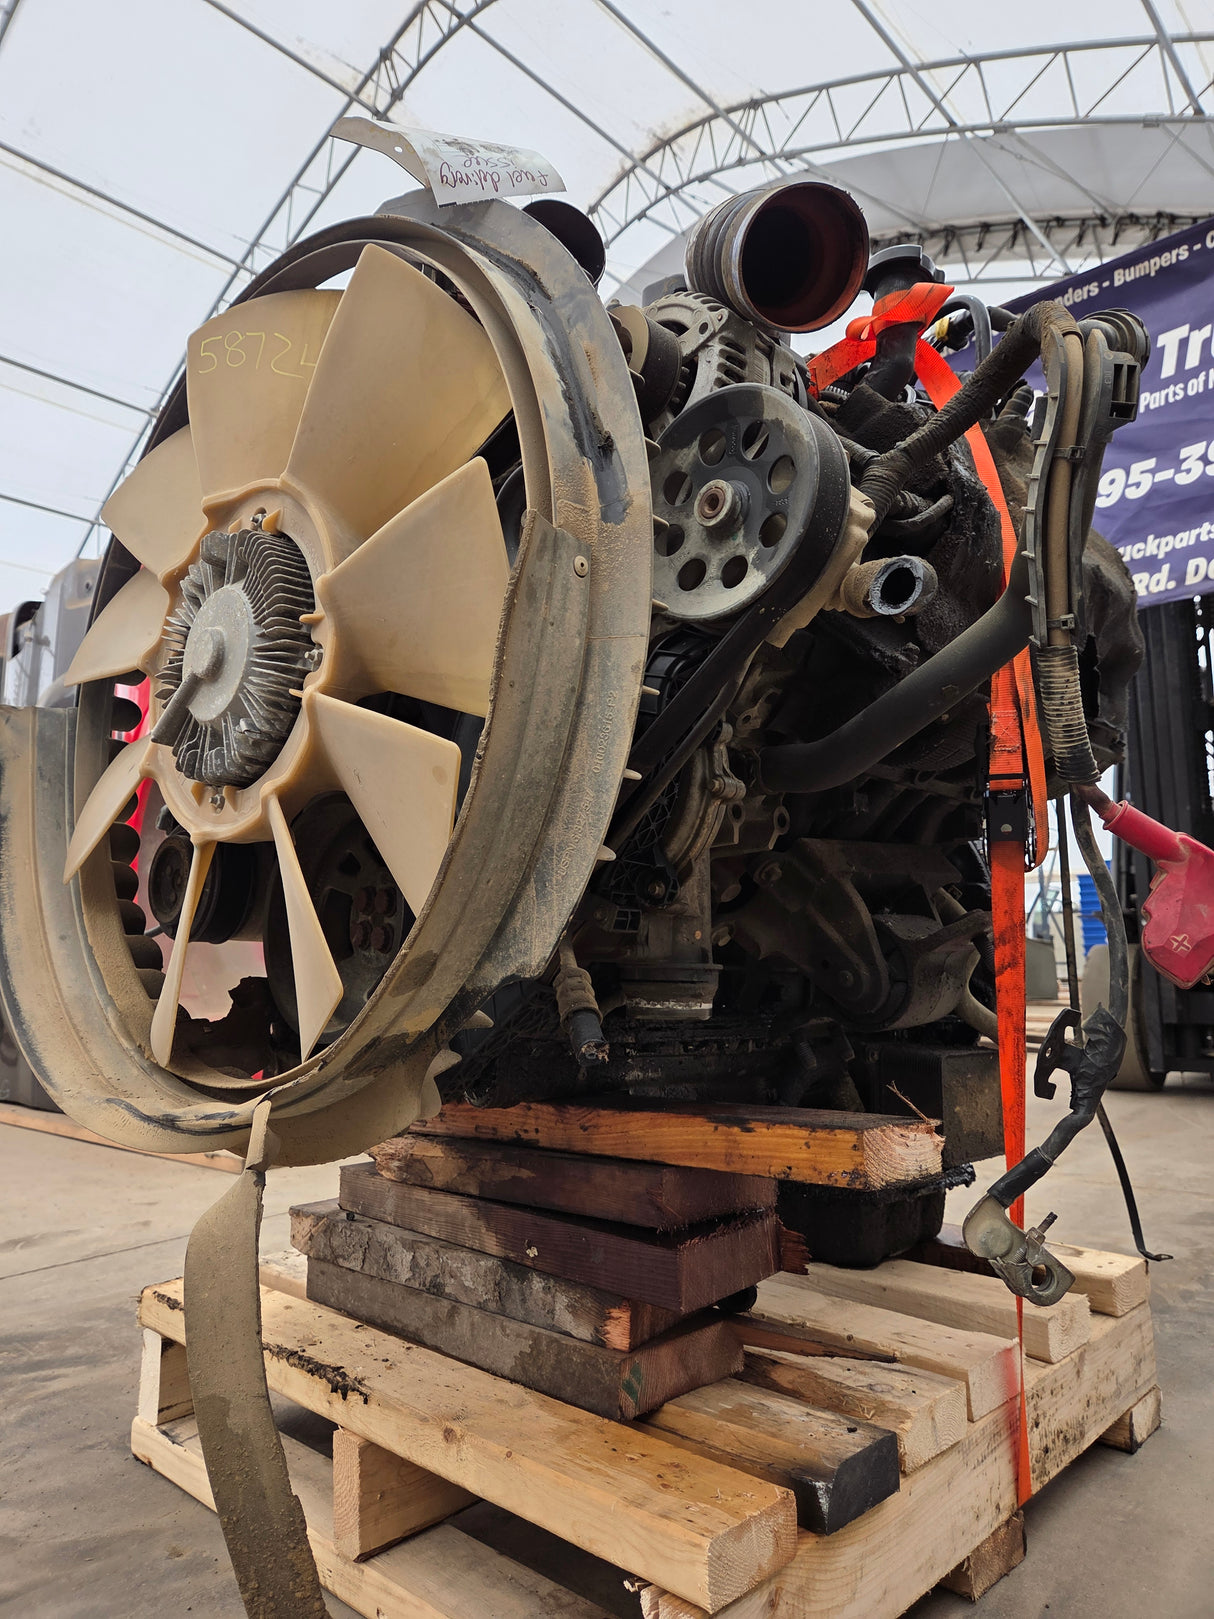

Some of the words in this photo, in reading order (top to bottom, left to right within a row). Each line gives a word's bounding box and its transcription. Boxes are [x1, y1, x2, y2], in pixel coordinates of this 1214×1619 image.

[439, 161, 501, 192] delivery
[506, 169, 549, 188] fuel
[1054, 281, 1099, 307] nders
[1113, 246, 1190, 287] Bumpers
[198, 330, 317, 379] 58724
[1156, 323, 1214, 379] Tr
[1139, 383, 1185, 414] Parts
[1187, 371, 1206, 396] of
[1132, 563, 1176, 597] Rd.
